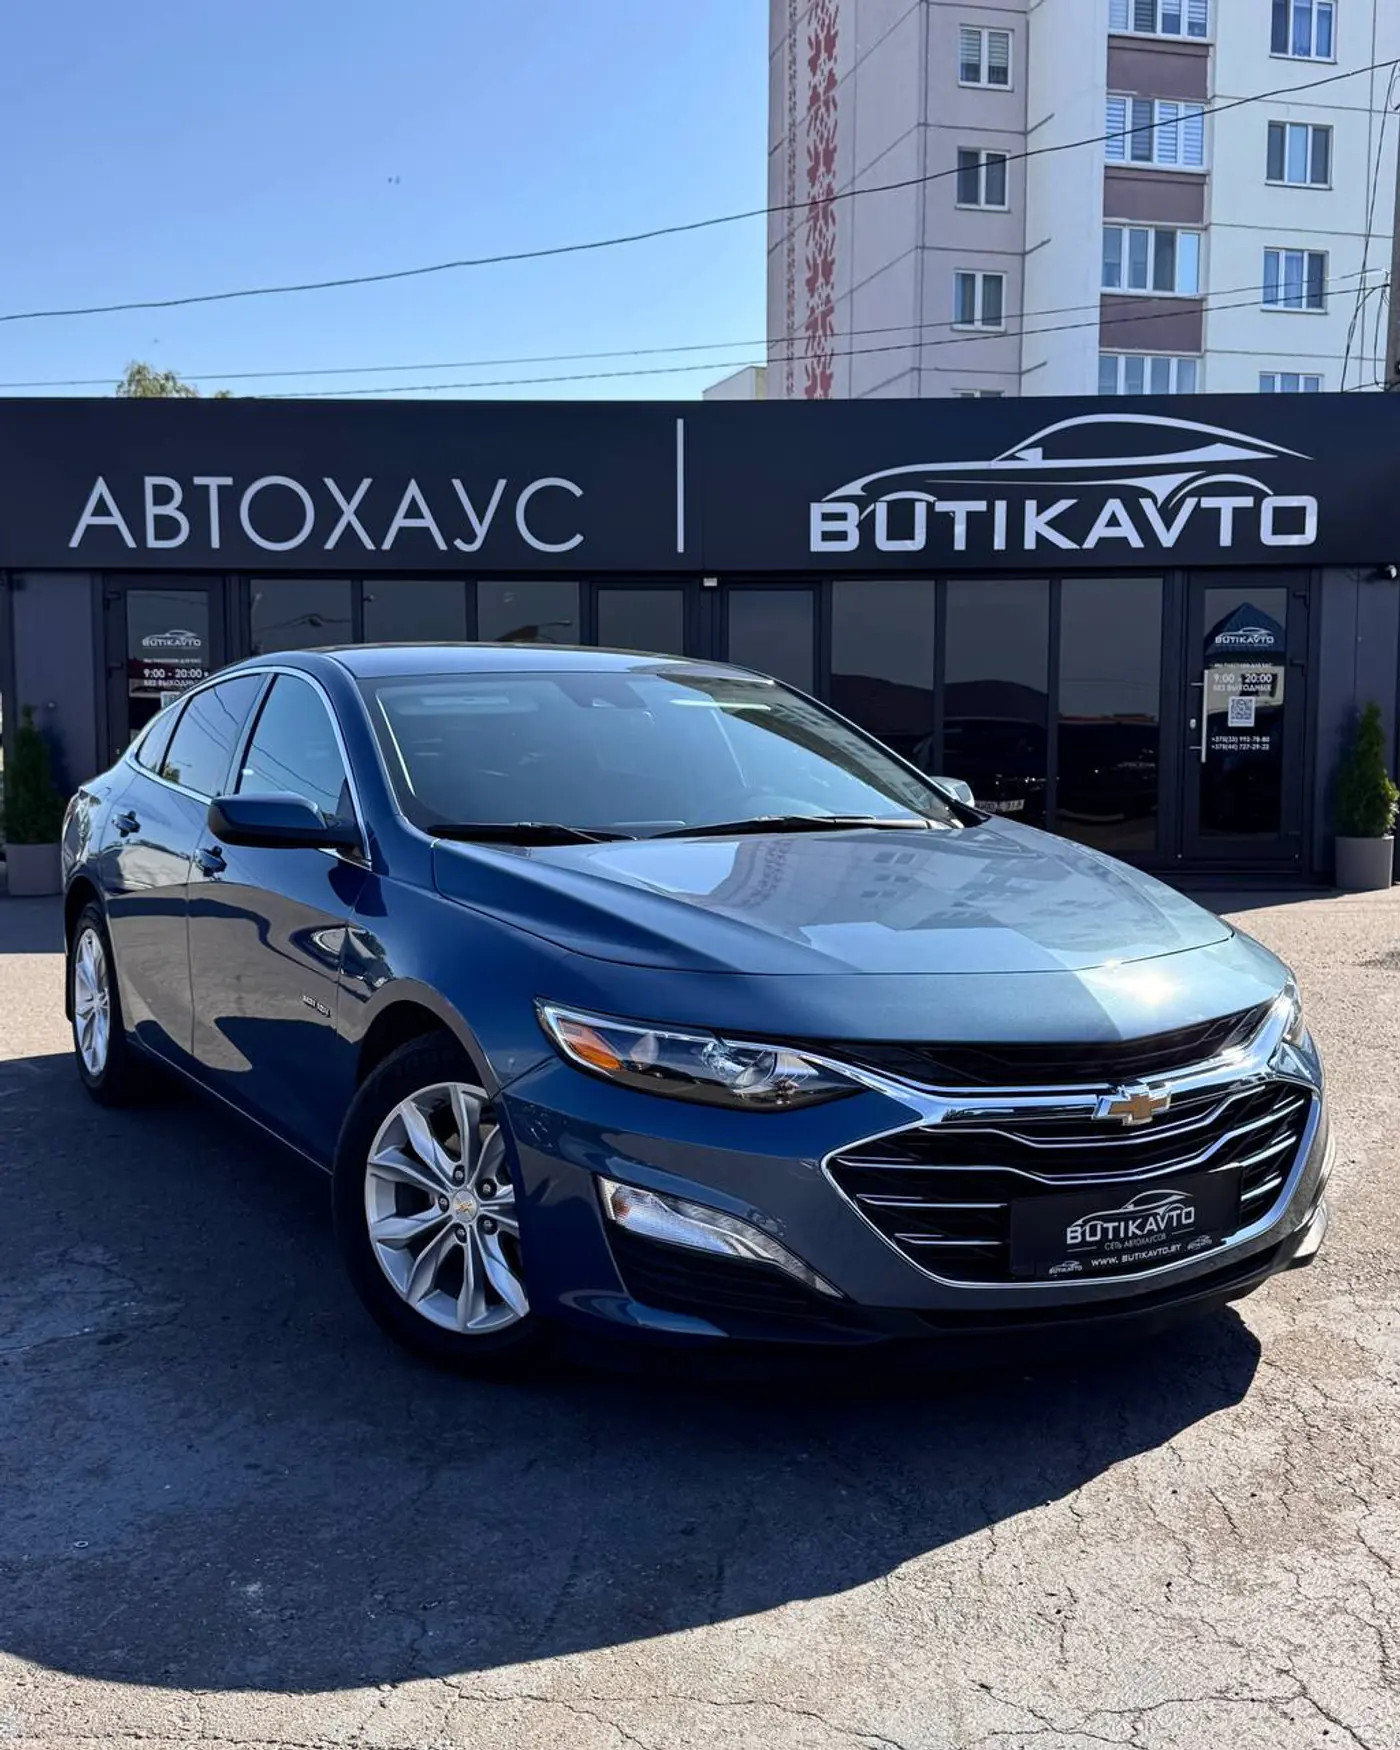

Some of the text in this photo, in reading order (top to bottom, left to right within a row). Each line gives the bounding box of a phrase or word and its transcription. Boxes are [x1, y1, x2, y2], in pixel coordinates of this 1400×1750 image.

[68, 474, 584, 552] АВТОХАУС
[809, 494, 1319, 552] BUTIKAVTO
[142, 638, 201, 646] BUTIKAVTO
[1215, 635, 1274, 644] BUTIKAVTO
[144, 668, 165, 678] 9:00
[175, 668, 202, 678] 20:00
[1214, 673, 1235, 683] 9:00
[1245, 673, 1273, 683] 20:00
[1066, 1206, 1195, 1245] BUTIKAVTO
[1121, 1244, 1180, 1262] BUTIKAVTO.BY
